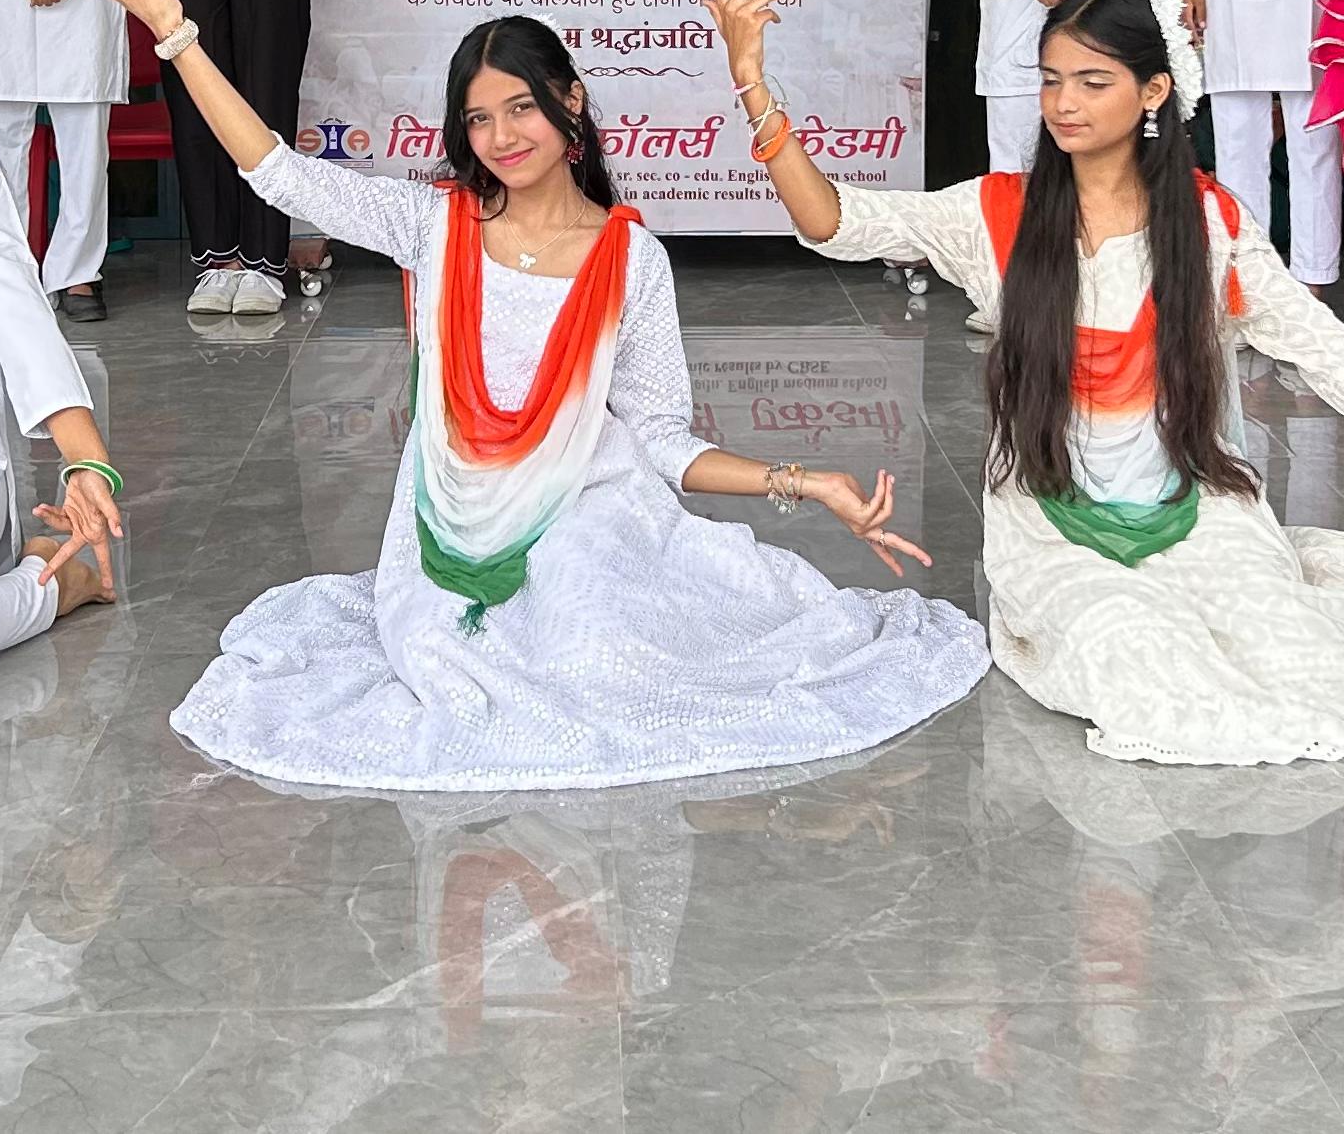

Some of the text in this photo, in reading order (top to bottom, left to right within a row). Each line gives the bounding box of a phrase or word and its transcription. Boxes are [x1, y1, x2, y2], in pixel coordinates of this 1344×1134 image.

[591, 21, 716, 55] श्रद्धांजलि
[795, 115, 908, 159] केडमी
[617, 171, 633, 181] sr.
[665, 171, 681, 182] co
[694, 169, 724, 182] edu.
[728, 169, 770, 185] Englis
[843, 169, 887, 182] school
[624, 186, 638, 201] in
[642, 187, 710, 201] academic
[714, 187, 761, 201] results
